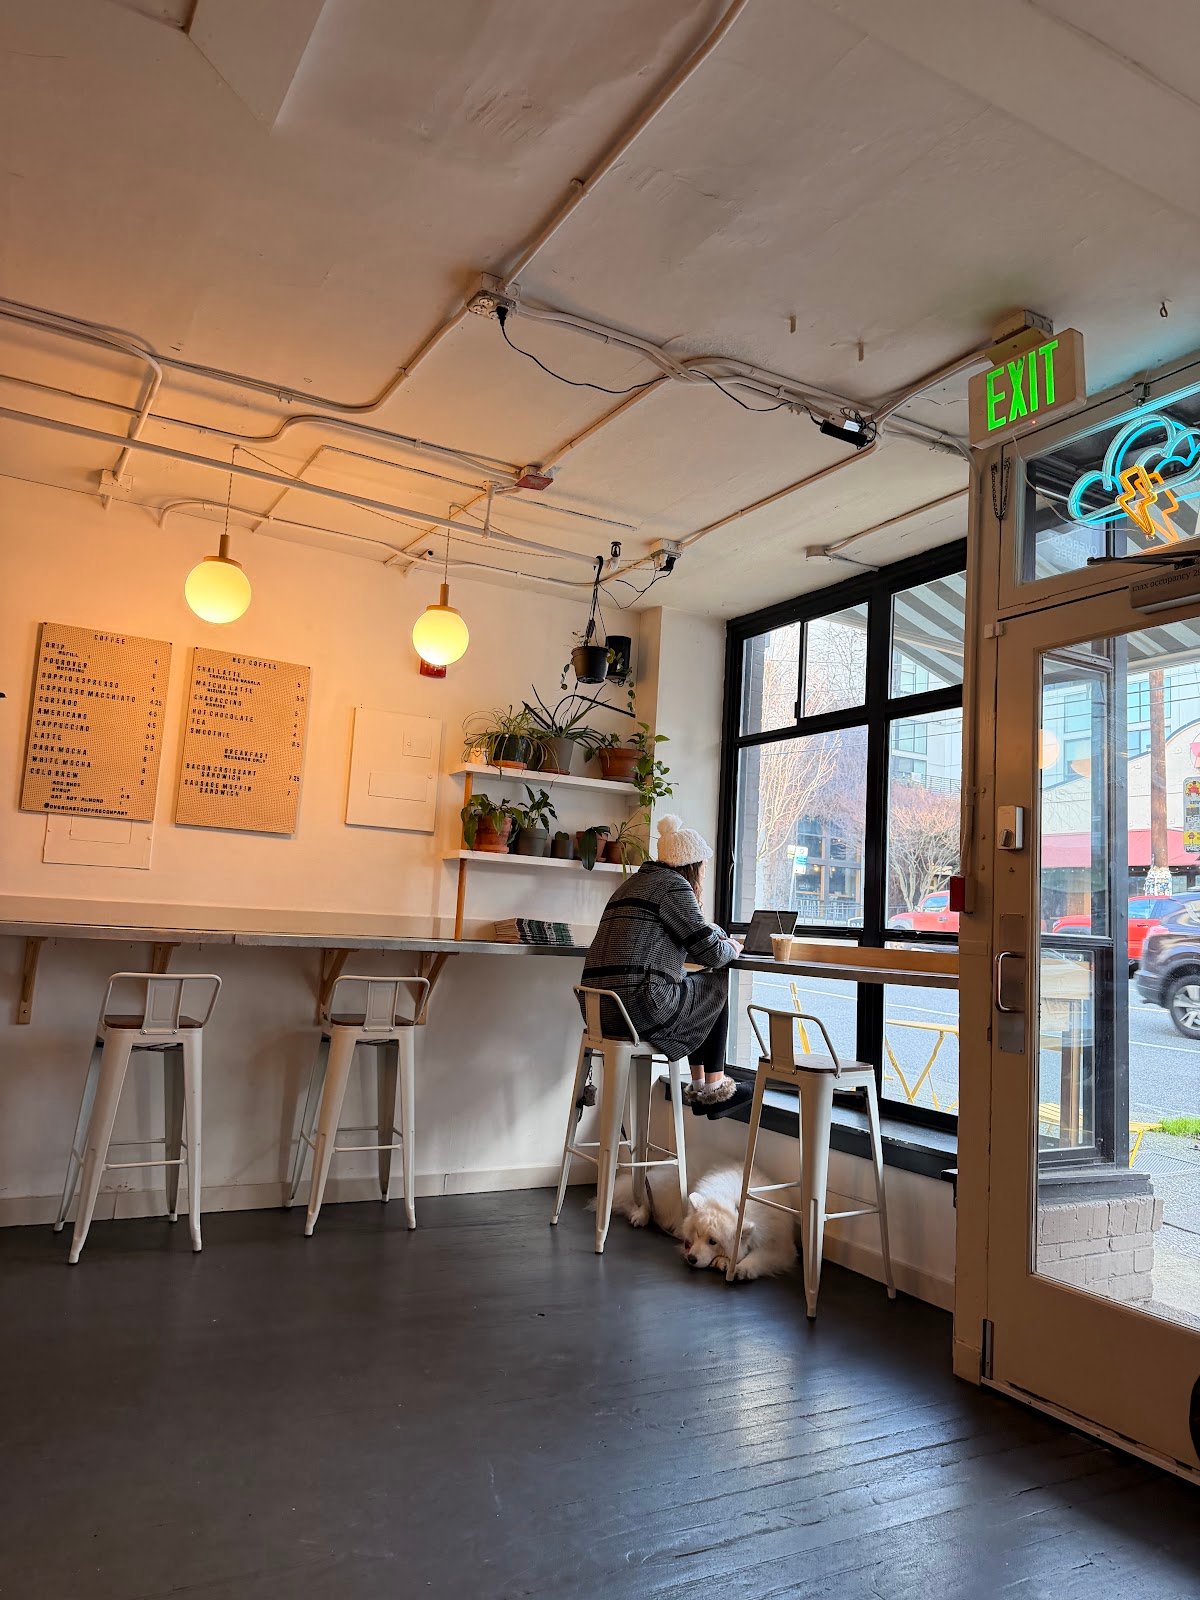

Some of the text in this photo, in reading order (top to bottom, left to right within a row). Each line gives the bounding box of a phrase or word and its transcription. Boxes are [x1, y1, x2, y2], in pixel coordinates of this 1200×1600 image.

[986, 339, 1059, 431] EXIT
[1150, 572, 1191, 588] occupancy
[45, 641, 65, 650] DRIP
[94, 634, 126, 645] COFFEE
[43, 657, 88, 668] POUROVER
[248, 660, 277, 670] COFFEE
[217, 669, 240, 678] LATTE
[75, 677, 119, 689] ESPRESSO
[195, 680, 227, 690] MATCHA
[229, 685, 253, 694] LATTE
[40, 684, 84, 696] ESPRESSO
[87, 690, 136, 703] MACCHIATO
[39, 696, 78, 706] CORTADO
[37, 708, 87, 720] AMERICANO
[192, 708, 206, 716] HOT
[209, 710, 254, 723] CHOCOLATE
[36, 720, 90, 732] CAPPUCCINO
[191, 717, 206, 726] TEA
[34, 732, 62, 741] LATTE
[189, 727, 230, 739] SMOOTHIE
[33, 743, 55, 752] DARK
[58, 746, 87, 756] MOCHA
[224, 748, 268, 760] BREAKFAST
[32, 755, 58, 765] WHITE
[62, 759, 91, 768] MOCHA
[30, 767, 52, 776] COLD
[55, 770, 79, 778] BREW
[186, 762, 257, 776] BACON CROISSANT
[201, 771, 241, 781] SANDWICH
[184, 779, 219, 788] SAUSAGE
[199, 787, 239, 797] SANDWICH
